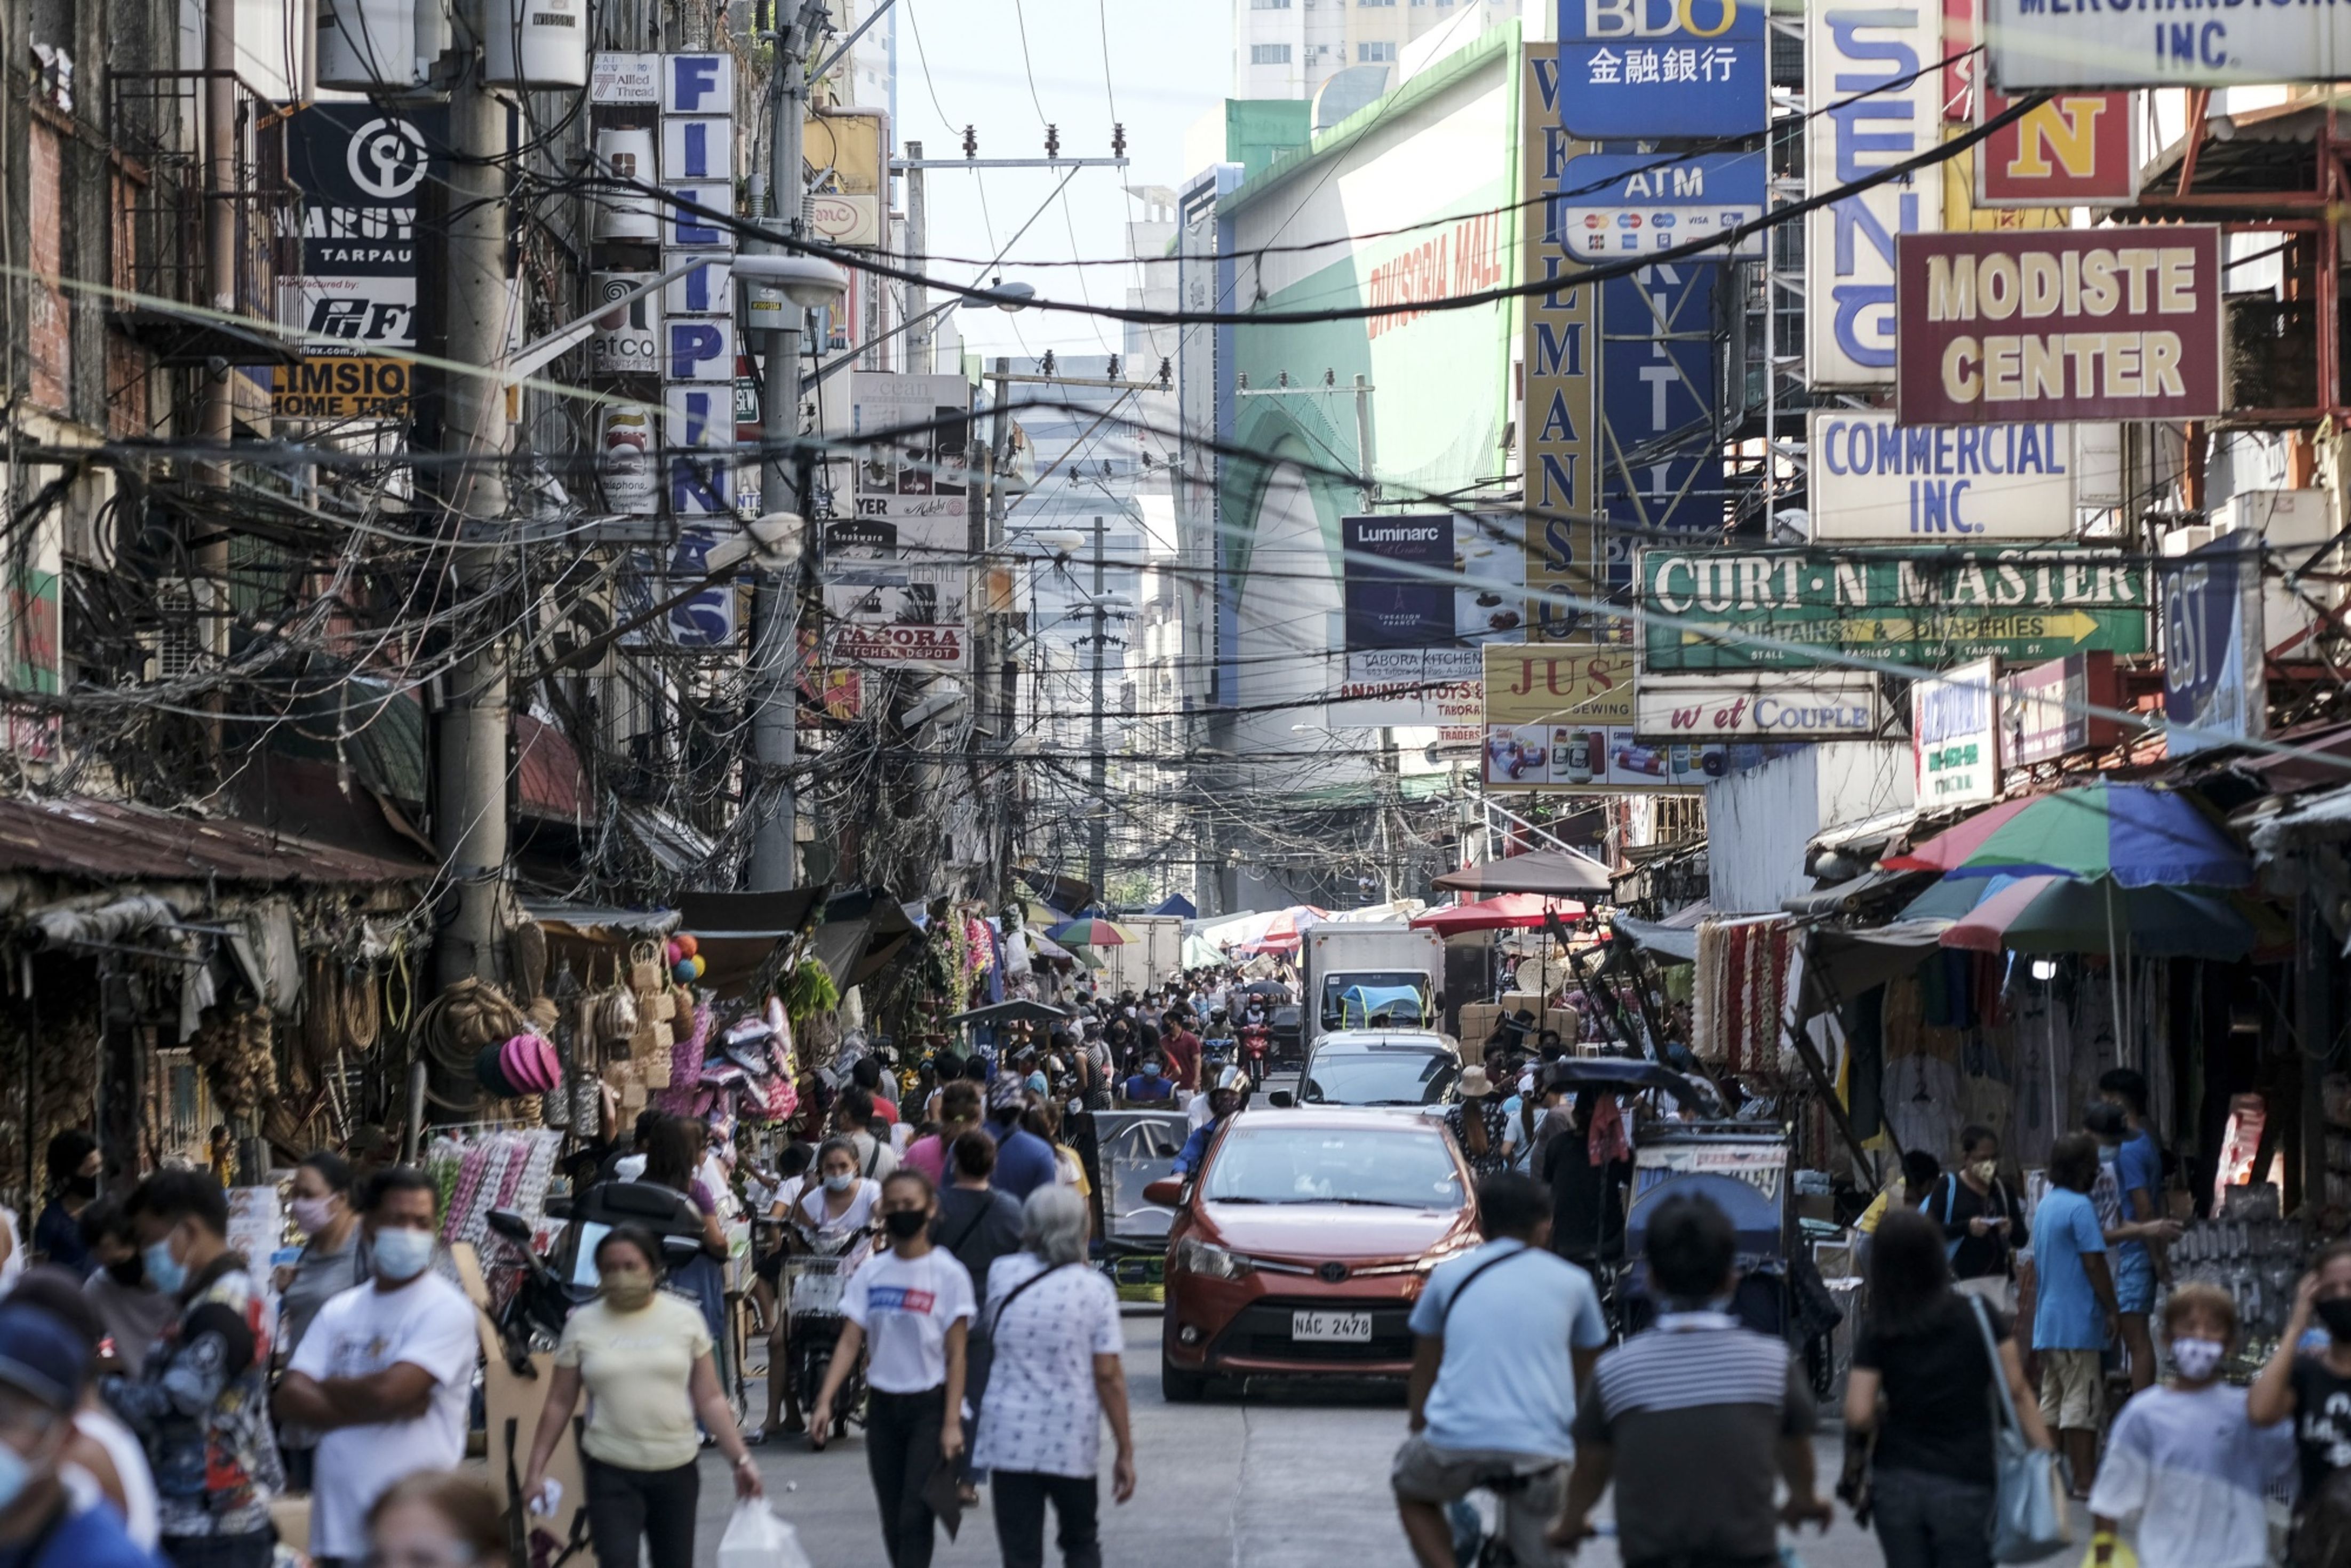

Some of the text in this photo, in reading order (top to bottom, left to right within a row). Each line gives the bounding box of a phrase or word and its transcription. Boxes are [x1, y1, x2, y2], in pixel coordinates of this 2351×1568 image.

[1586, 0, 1737, 37] BDO
[2156, 21, 2241, 70] INC.
[1588, 46, 1737, 84] 金融銀行
[617, 75, 649, 84] Allied
[616, 87, 654, 97] Thread
[1624, 167, 1703, 198] ATM
[1689, 216, 1709, 225] VISA
[321, 249, 412, 262] TARPAU
[1369, 207, 1501, 340] DIVISORIA MALL
[1927, 247, 2196, 322] MODISTE
[670, 57, 728, 645] FILIPINAS
[1942, 331, 2186, 403] CENTER
[1825, 421, 2066, 476] COMMERCIAL
[1910, 480, 1985, 533] INC.
[1359, 524, 1439, 542] Luminarc
[1896, 548, 2136, 606] MASTER
[907, 649, 951, 658] DEPOT
[1363, 654, 1418, 667] TABORA
[1437, 704, 1481, 716] TABORA
[1572, 703, 1629, 715] SEWING
[1440, 730, 1480, 741] TRADERS
[1295, 1318, 1369, 1335] NAC 2478
